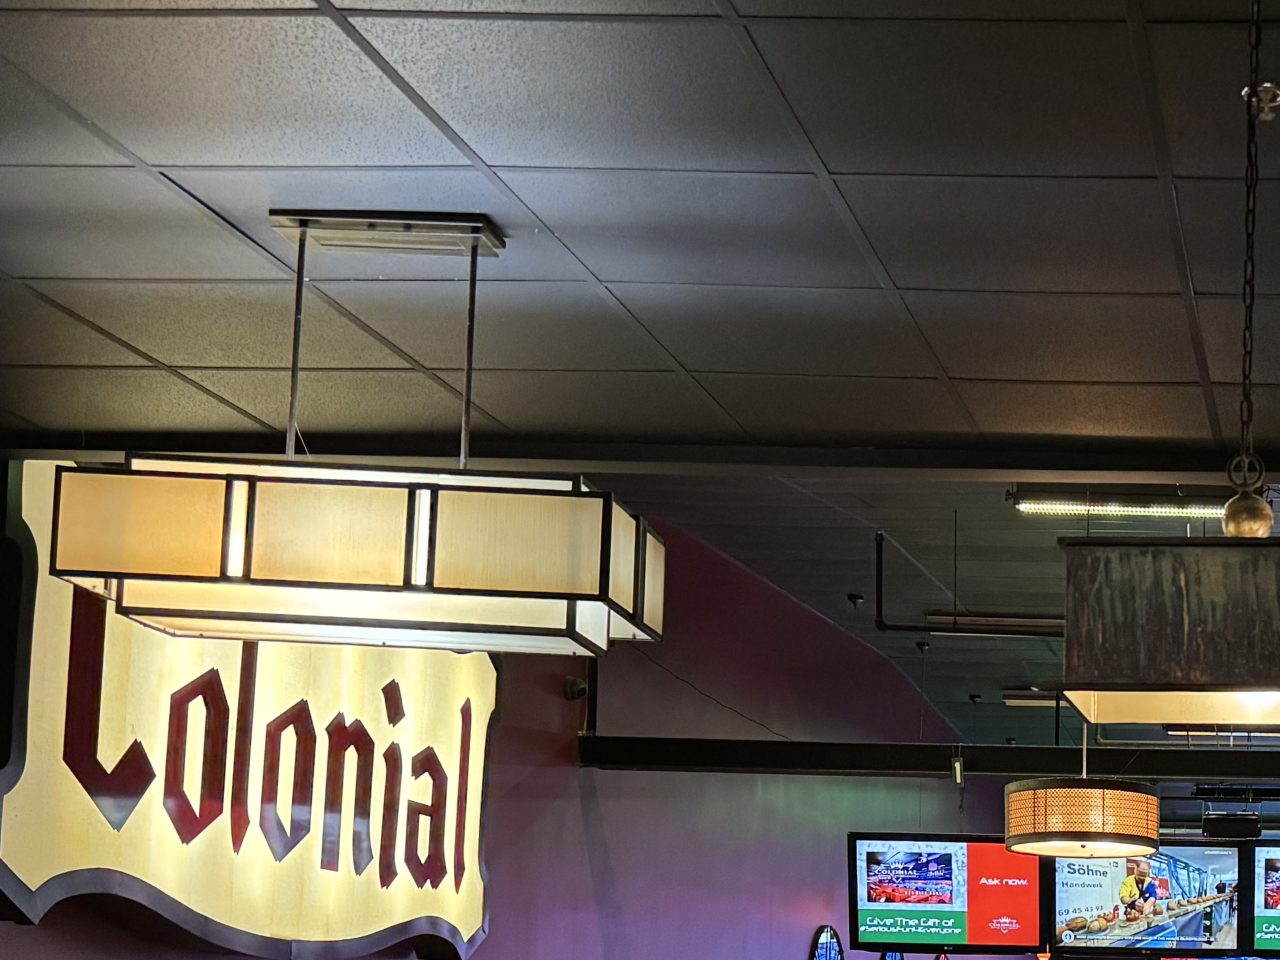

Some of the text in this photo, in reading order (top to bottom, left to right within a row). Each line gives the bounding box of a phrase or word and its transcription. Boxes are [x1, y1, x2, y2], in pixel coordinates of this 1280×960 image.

[954, 761, 961, 784] 1
[1066, 863, 1108, 878] Söhne
[979, 877, 1029, 886] Ask now.
[1061, 881, 1103, 889] Handwerk
[1058, 908, 1070, 917] 69
[867, 917, 954, 926] Give The Gift of
